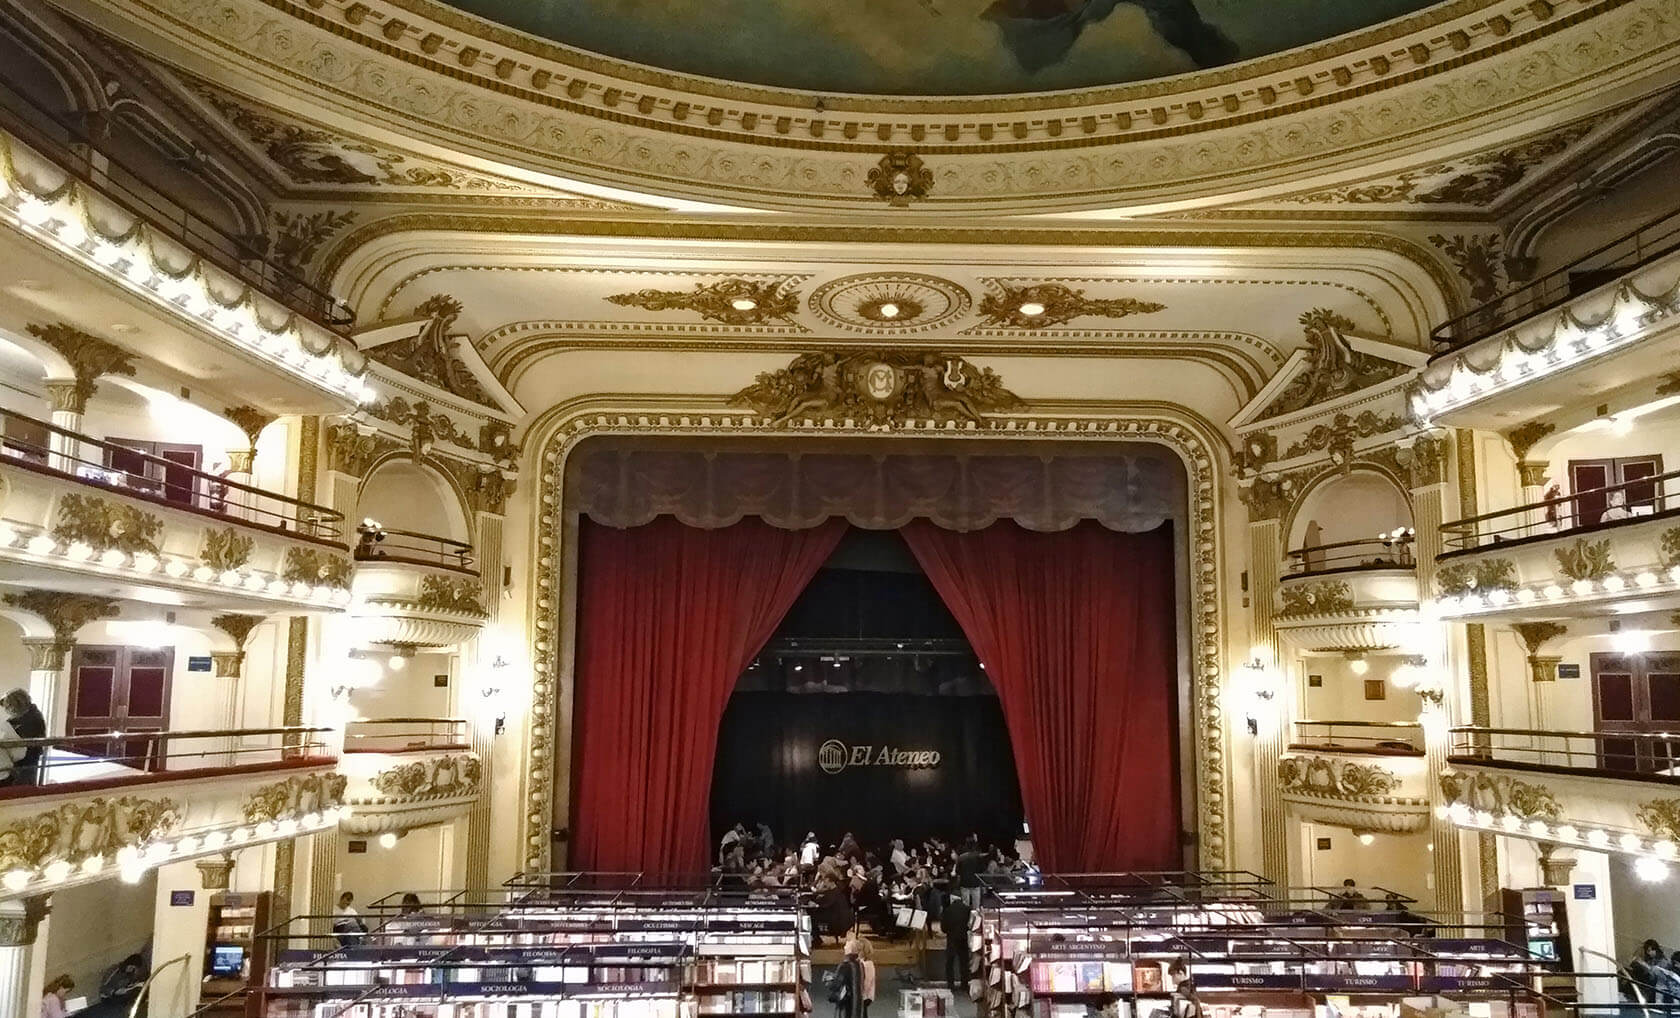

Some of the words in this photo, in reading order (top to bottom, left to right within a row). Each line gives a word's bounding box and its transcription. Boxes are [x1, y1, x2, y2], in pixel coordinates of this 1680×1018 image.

[848, 745, 872, 766] El
[873, 745, 942, 766] Ateneo
[1231, 977, 1264, 985] TURISMO
[1344, 977, 1378, 985] TURISMO
